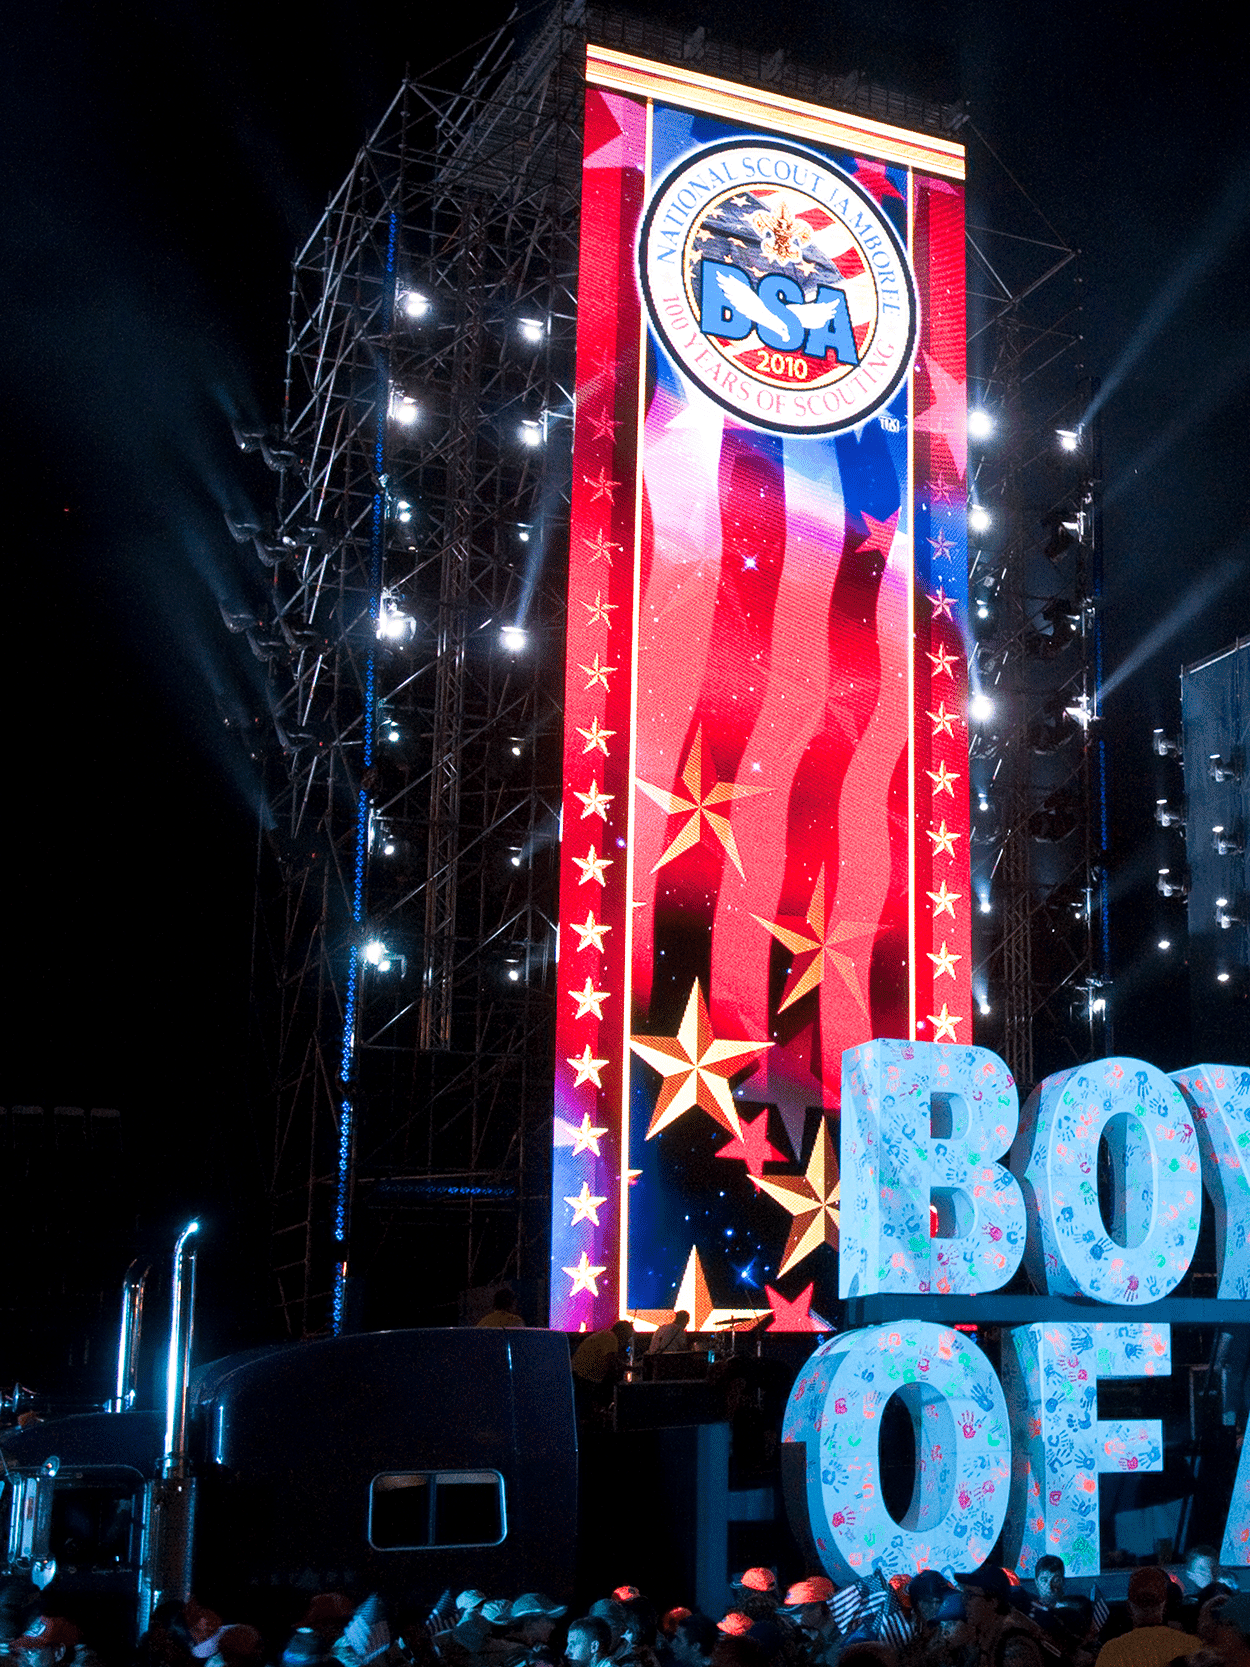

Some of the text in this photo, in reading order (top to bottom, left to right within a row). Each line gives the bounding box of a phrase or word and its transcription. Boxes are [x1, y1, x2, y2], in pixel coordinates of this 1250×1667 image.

[657, 156, 901, 317] NATIONAL SCOUT JAMBOREE
[662, 293, 895, 418] 100 YEARS OF SCOUTING
[700, 256, 861, 368] BSA
[755, 350, 808, 380] 2010
[781, 1319, 1172, 1582] OF
